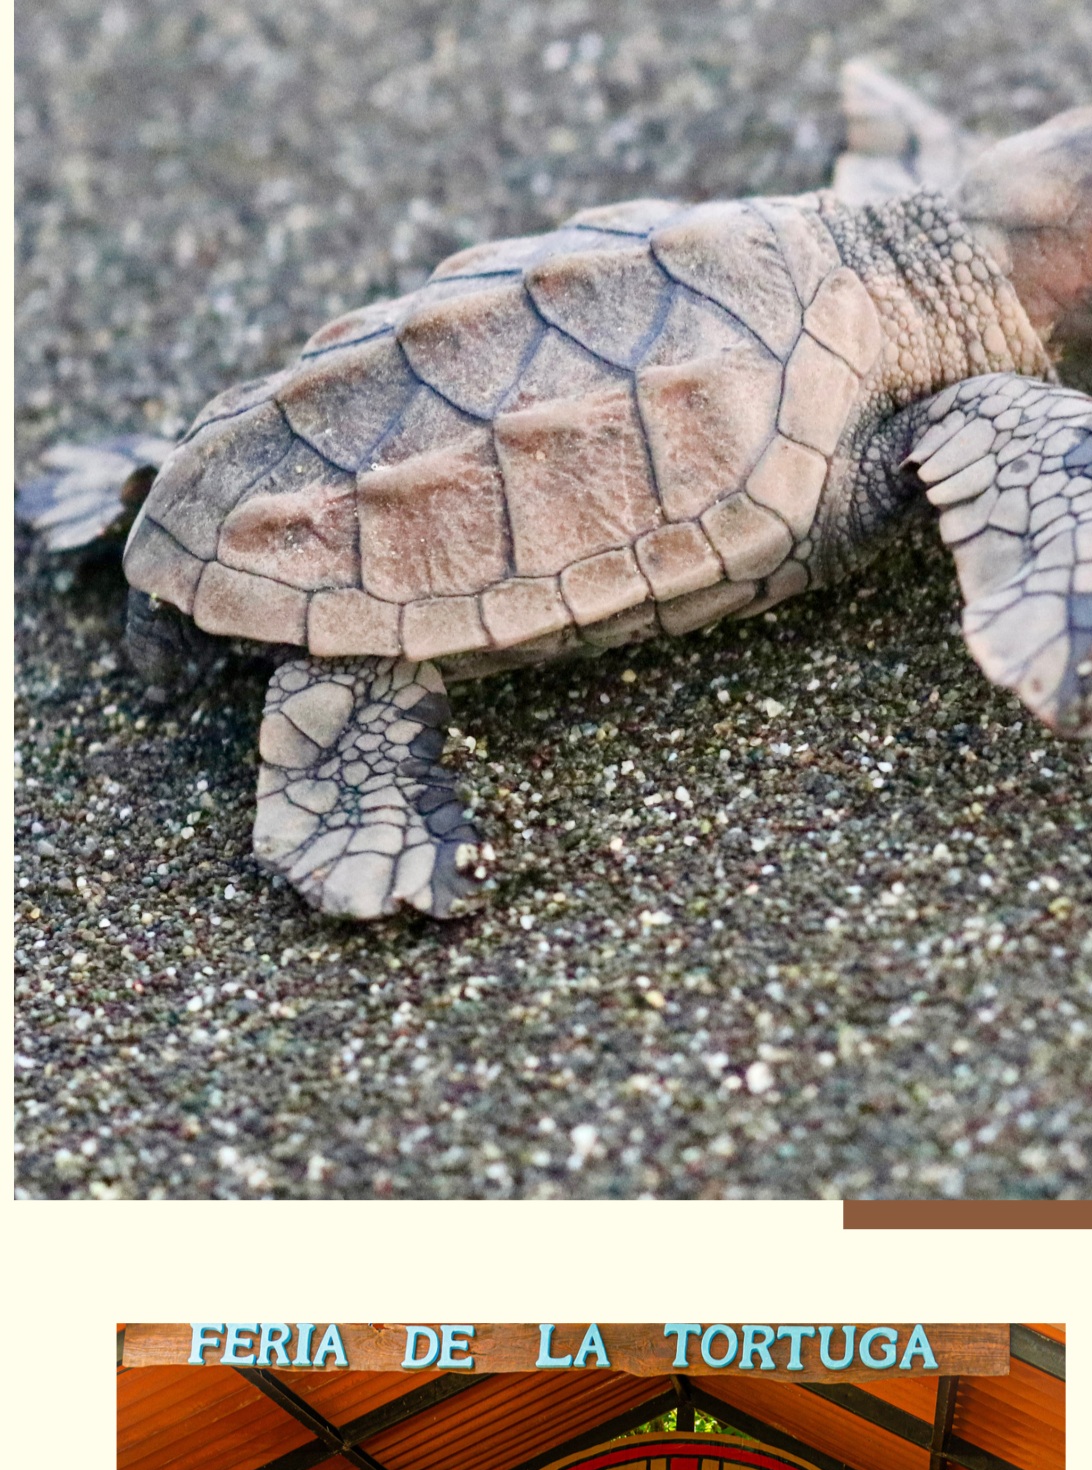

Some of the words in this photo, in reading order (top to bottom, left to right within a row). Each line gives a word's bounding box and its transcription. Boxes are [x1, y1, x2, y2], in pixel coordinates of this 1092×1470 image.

[188, 1323, 349, 1367] FERIA
[401, 1325, 475, 1370] DE
[536, 1323, 611, 1369] LA
[664, 1323, 939, 1371] TORTUGA
